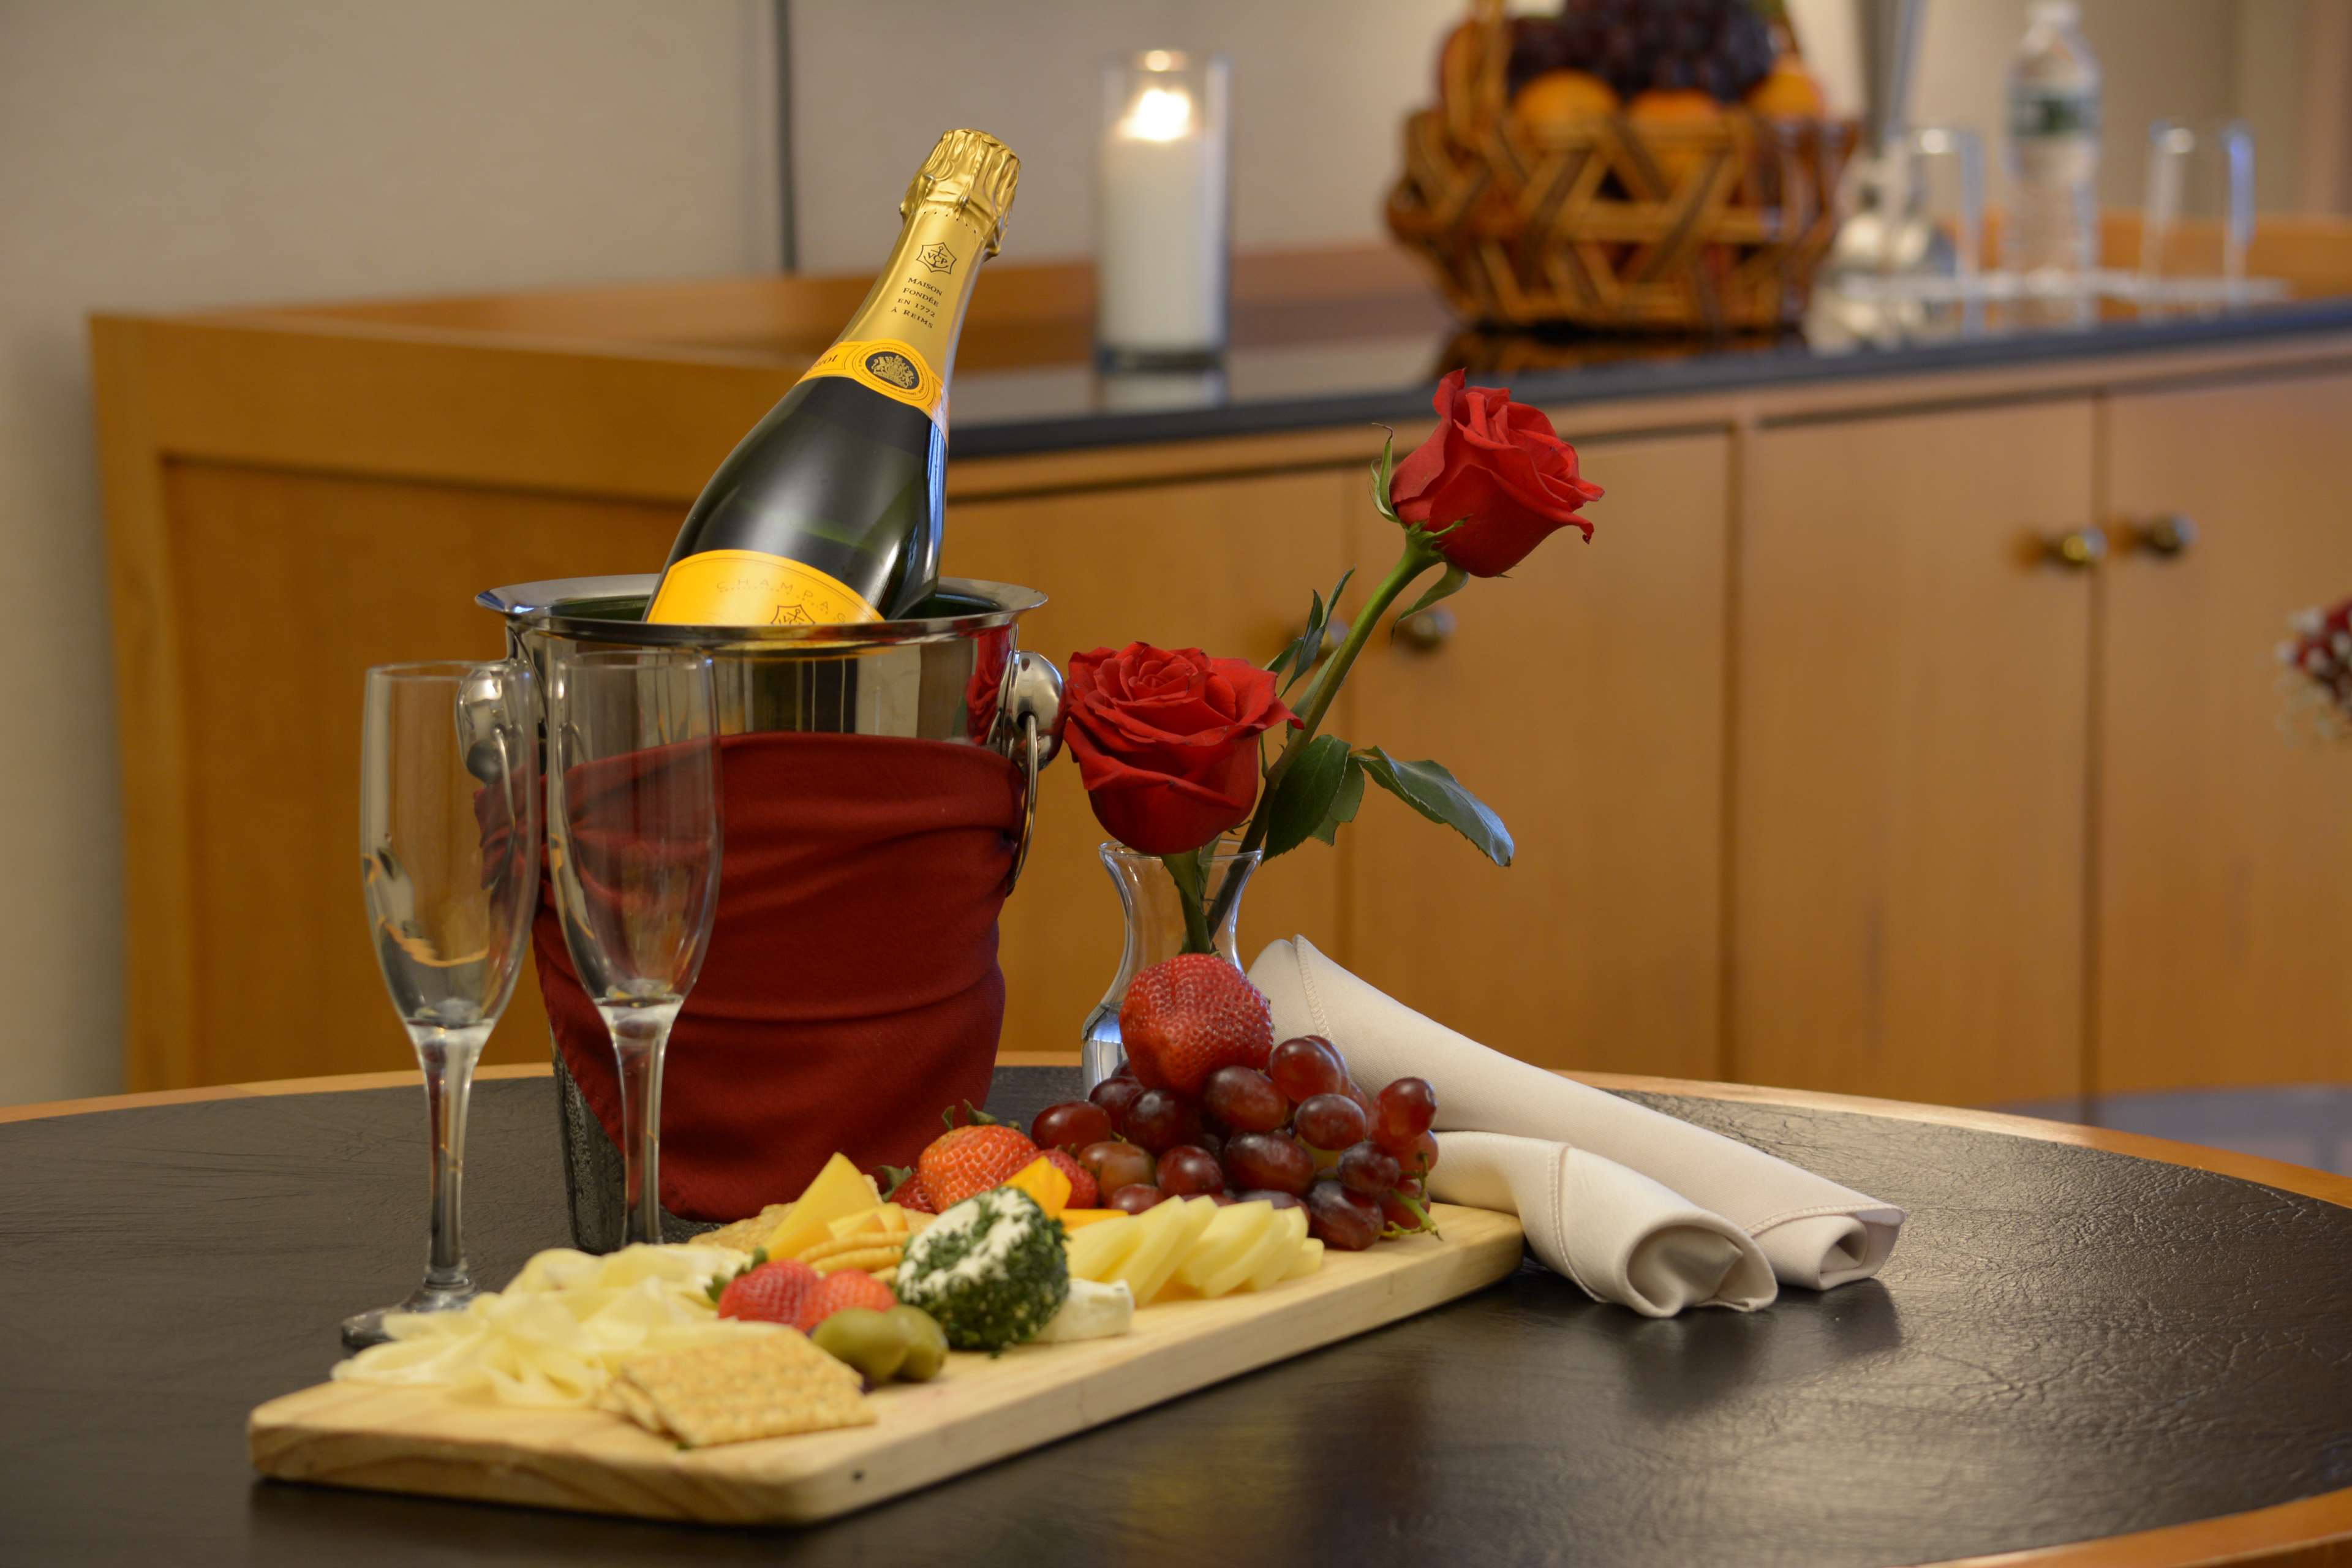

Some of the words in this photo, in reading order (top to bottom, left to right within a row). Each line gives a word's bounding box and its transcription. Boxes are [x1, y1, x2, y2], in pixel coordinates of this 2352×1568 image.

[927, 252, 948, 265] VCP
[908, 277, 943, 296] MAISON
[902, 287, 940, 307] FONDÉE
[903, 309, 933, 329] REIMS
[914, 303, 936, 318] 1772
